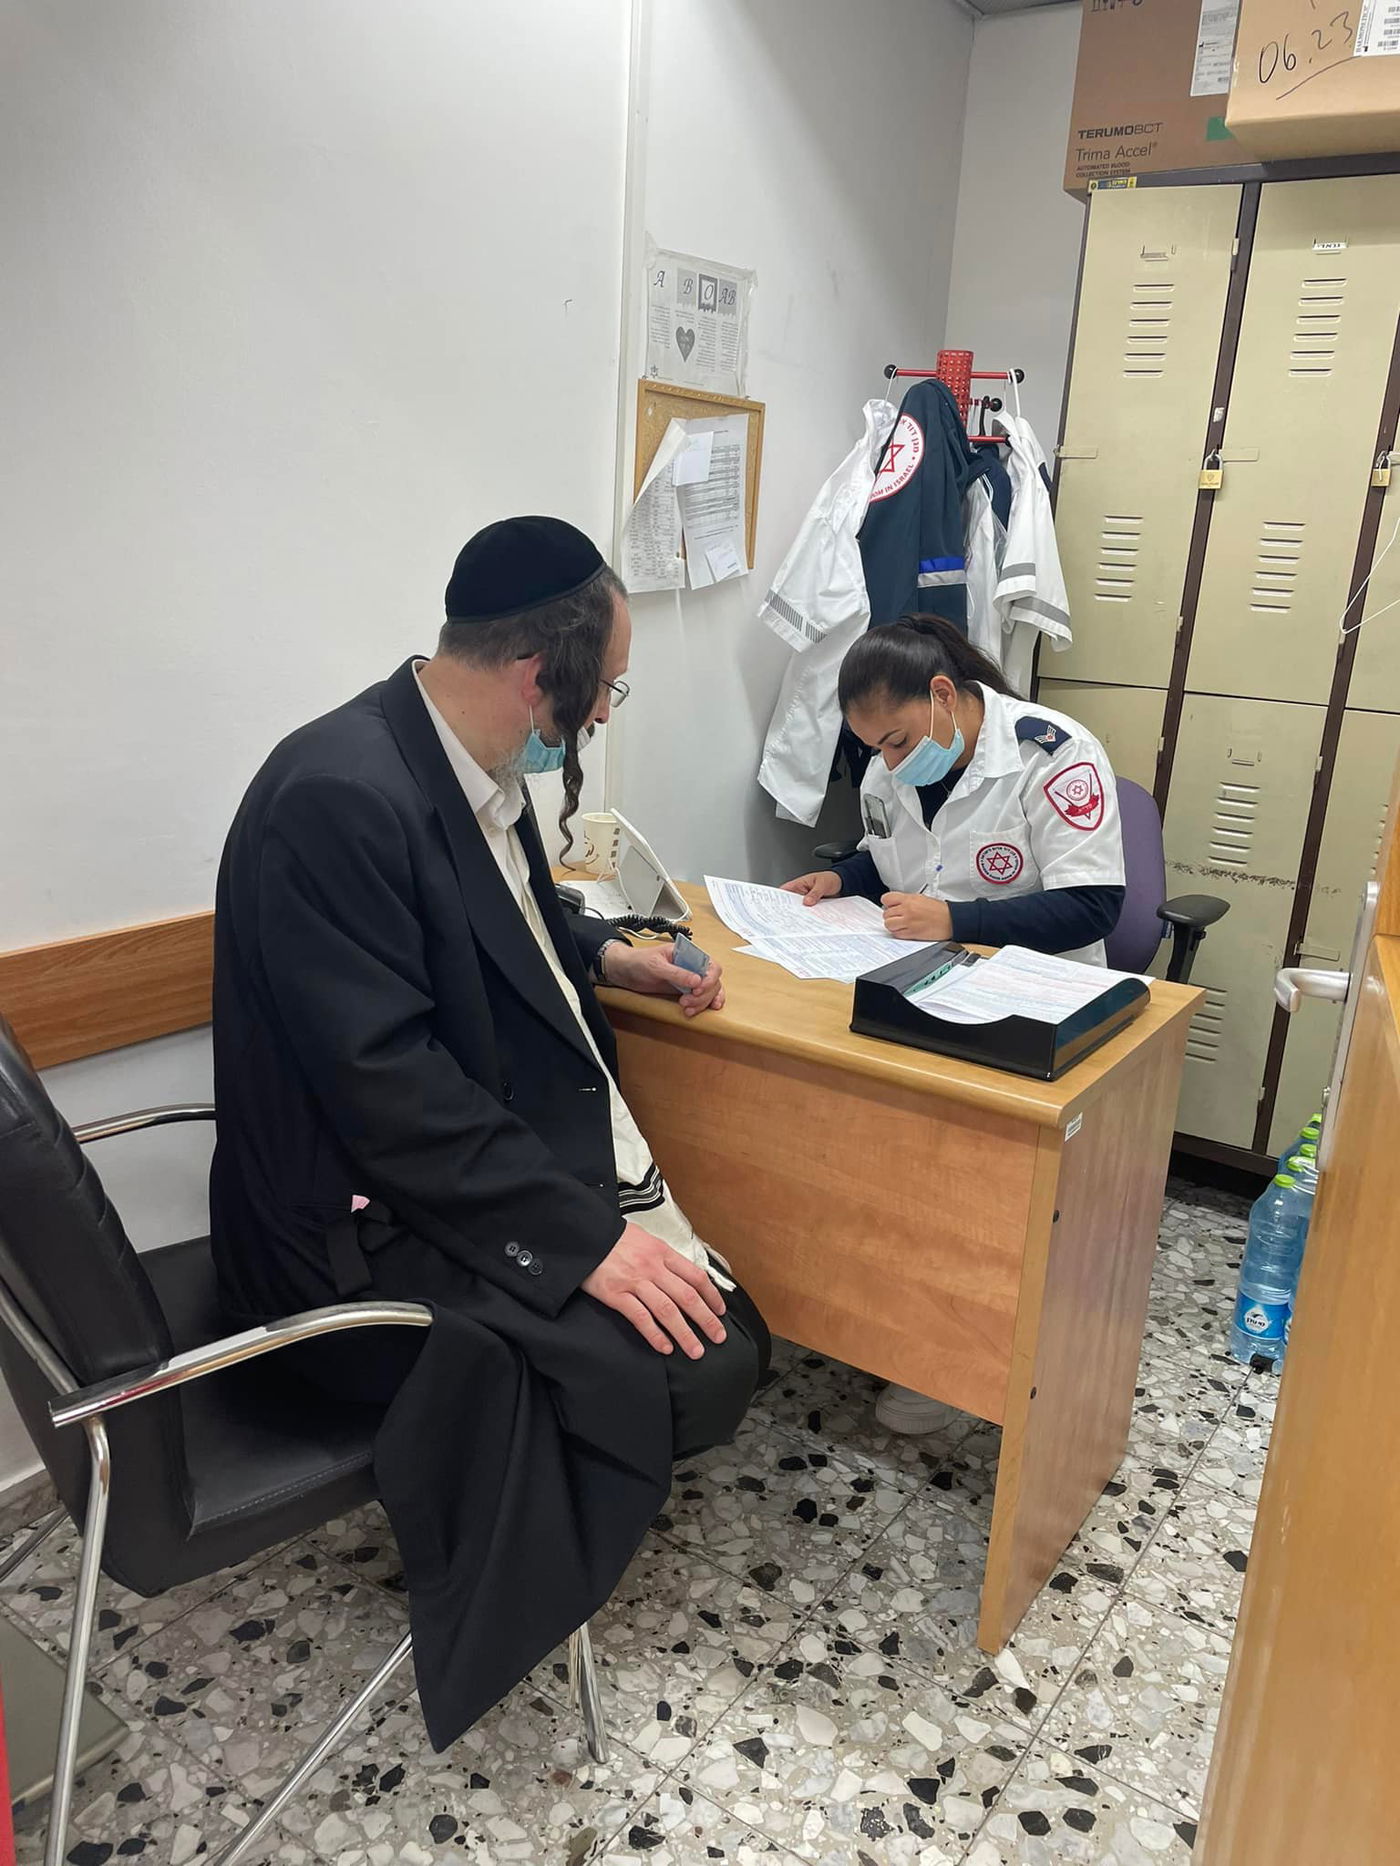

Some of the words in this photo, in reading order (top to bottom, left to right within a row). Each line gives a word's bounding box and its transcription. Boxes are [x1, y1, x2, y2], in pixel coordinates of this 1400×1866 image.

[1078, 122, 1163, 139] TERUMOBCT
[1075, 147, 1111, 161] Trima
[653, 270, 666, 288] A
[683, 278, 694, 295] B
[704, 283, 714, 301] O
[884, 484, 894, 493] IN
[893, 464, 915, 487] ISRAEL
